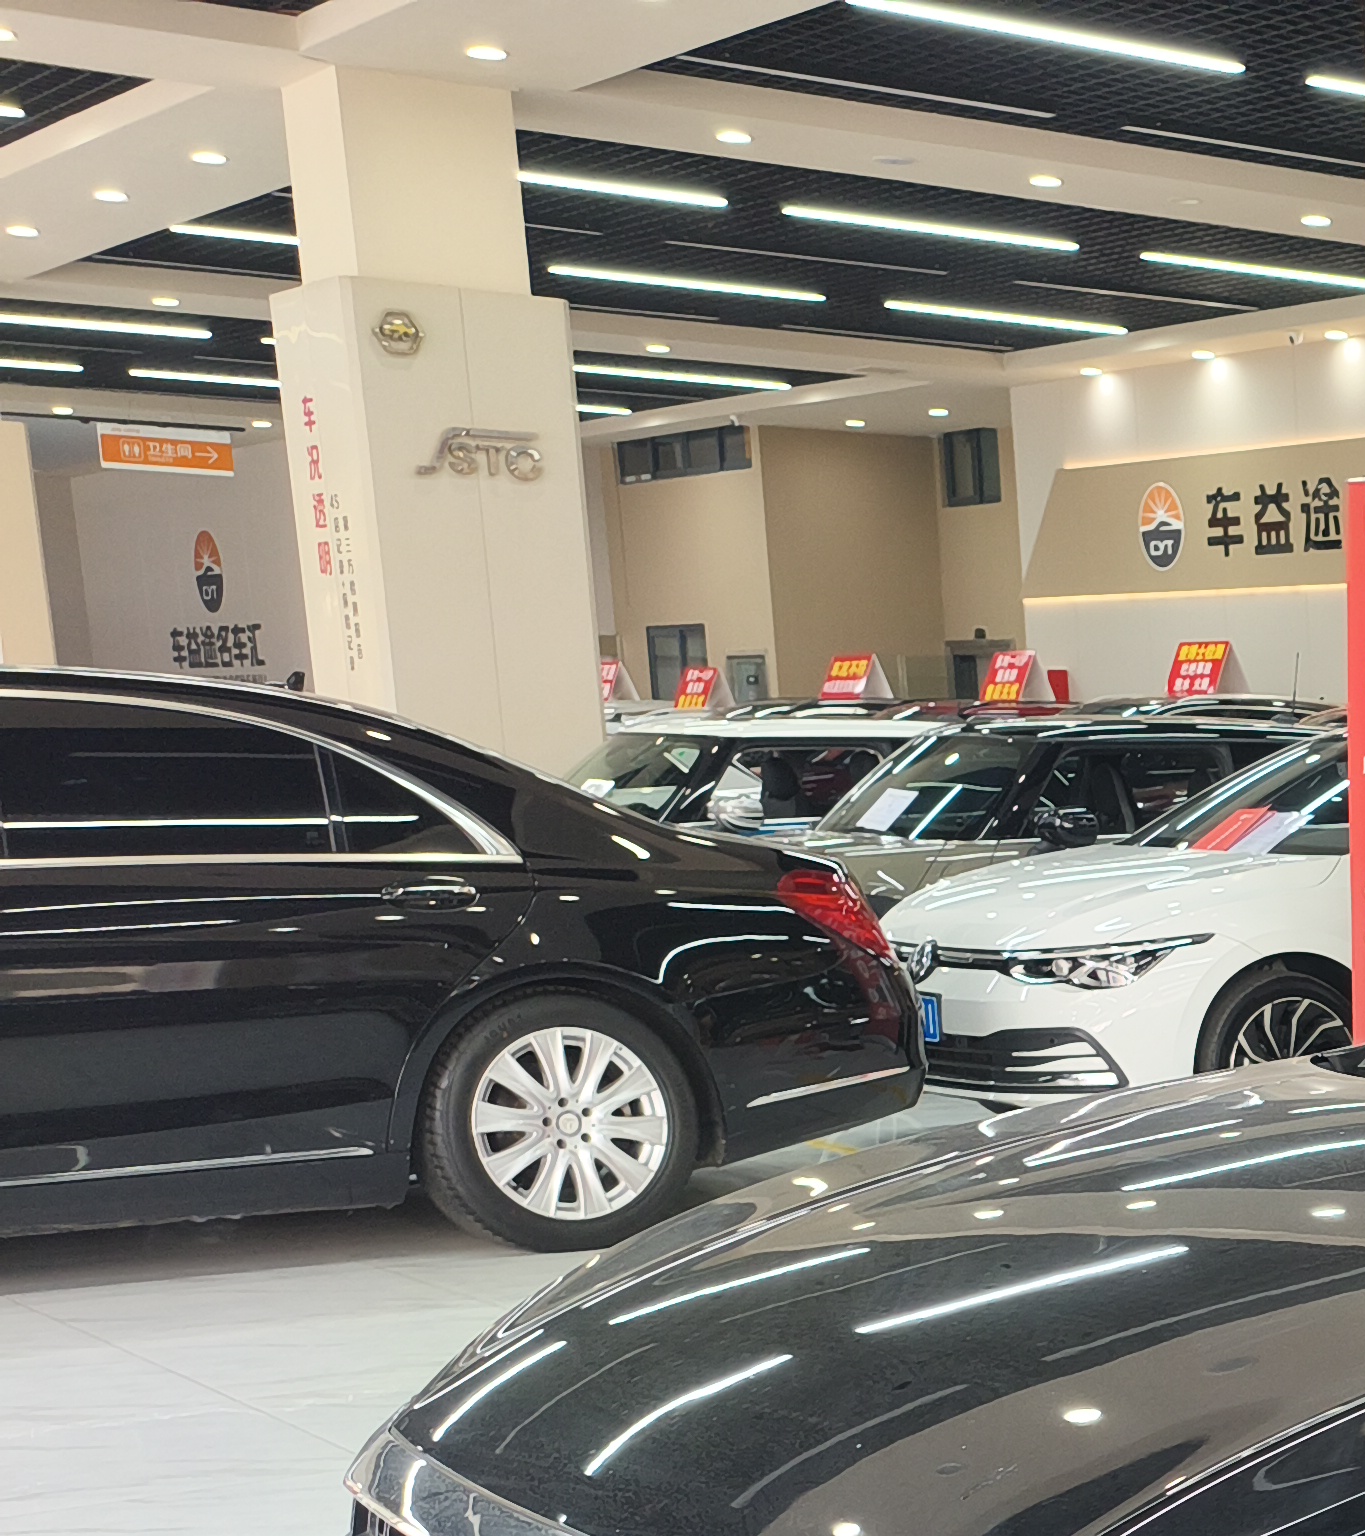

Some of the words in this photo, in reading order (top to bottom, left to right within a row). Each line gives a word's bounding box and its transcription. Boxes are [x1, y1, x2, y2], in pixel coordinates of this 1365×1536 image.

[145, 441, 192, 459] 卫生间
[302, 396, 333, 577] 车况透明
[1206, 477, 1343, 558] 车益途
[169, 623, 267, 670] 车益途名车汇
